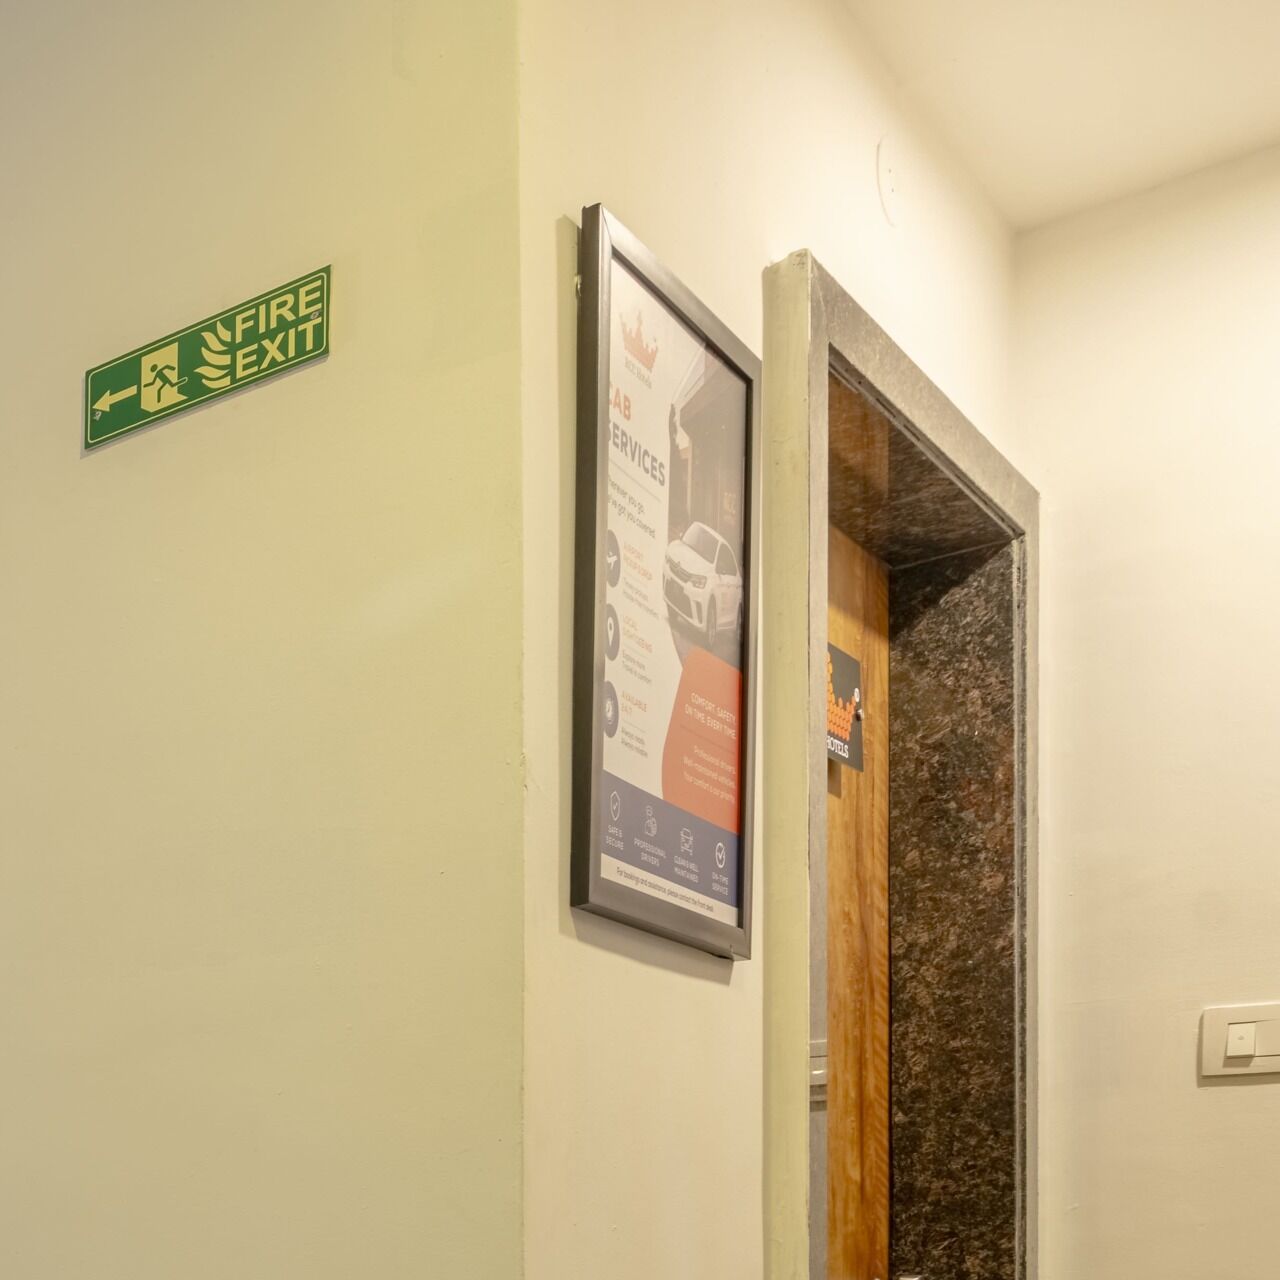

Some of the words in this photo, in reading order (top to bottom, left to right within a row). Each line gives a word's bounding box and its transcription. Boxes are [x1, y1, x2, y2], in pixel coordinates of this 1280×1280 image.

[236, 279, 322, 344] FIRE
[236, 317, 322, 379] EXIT
[609, 382, 631, 420] AB
